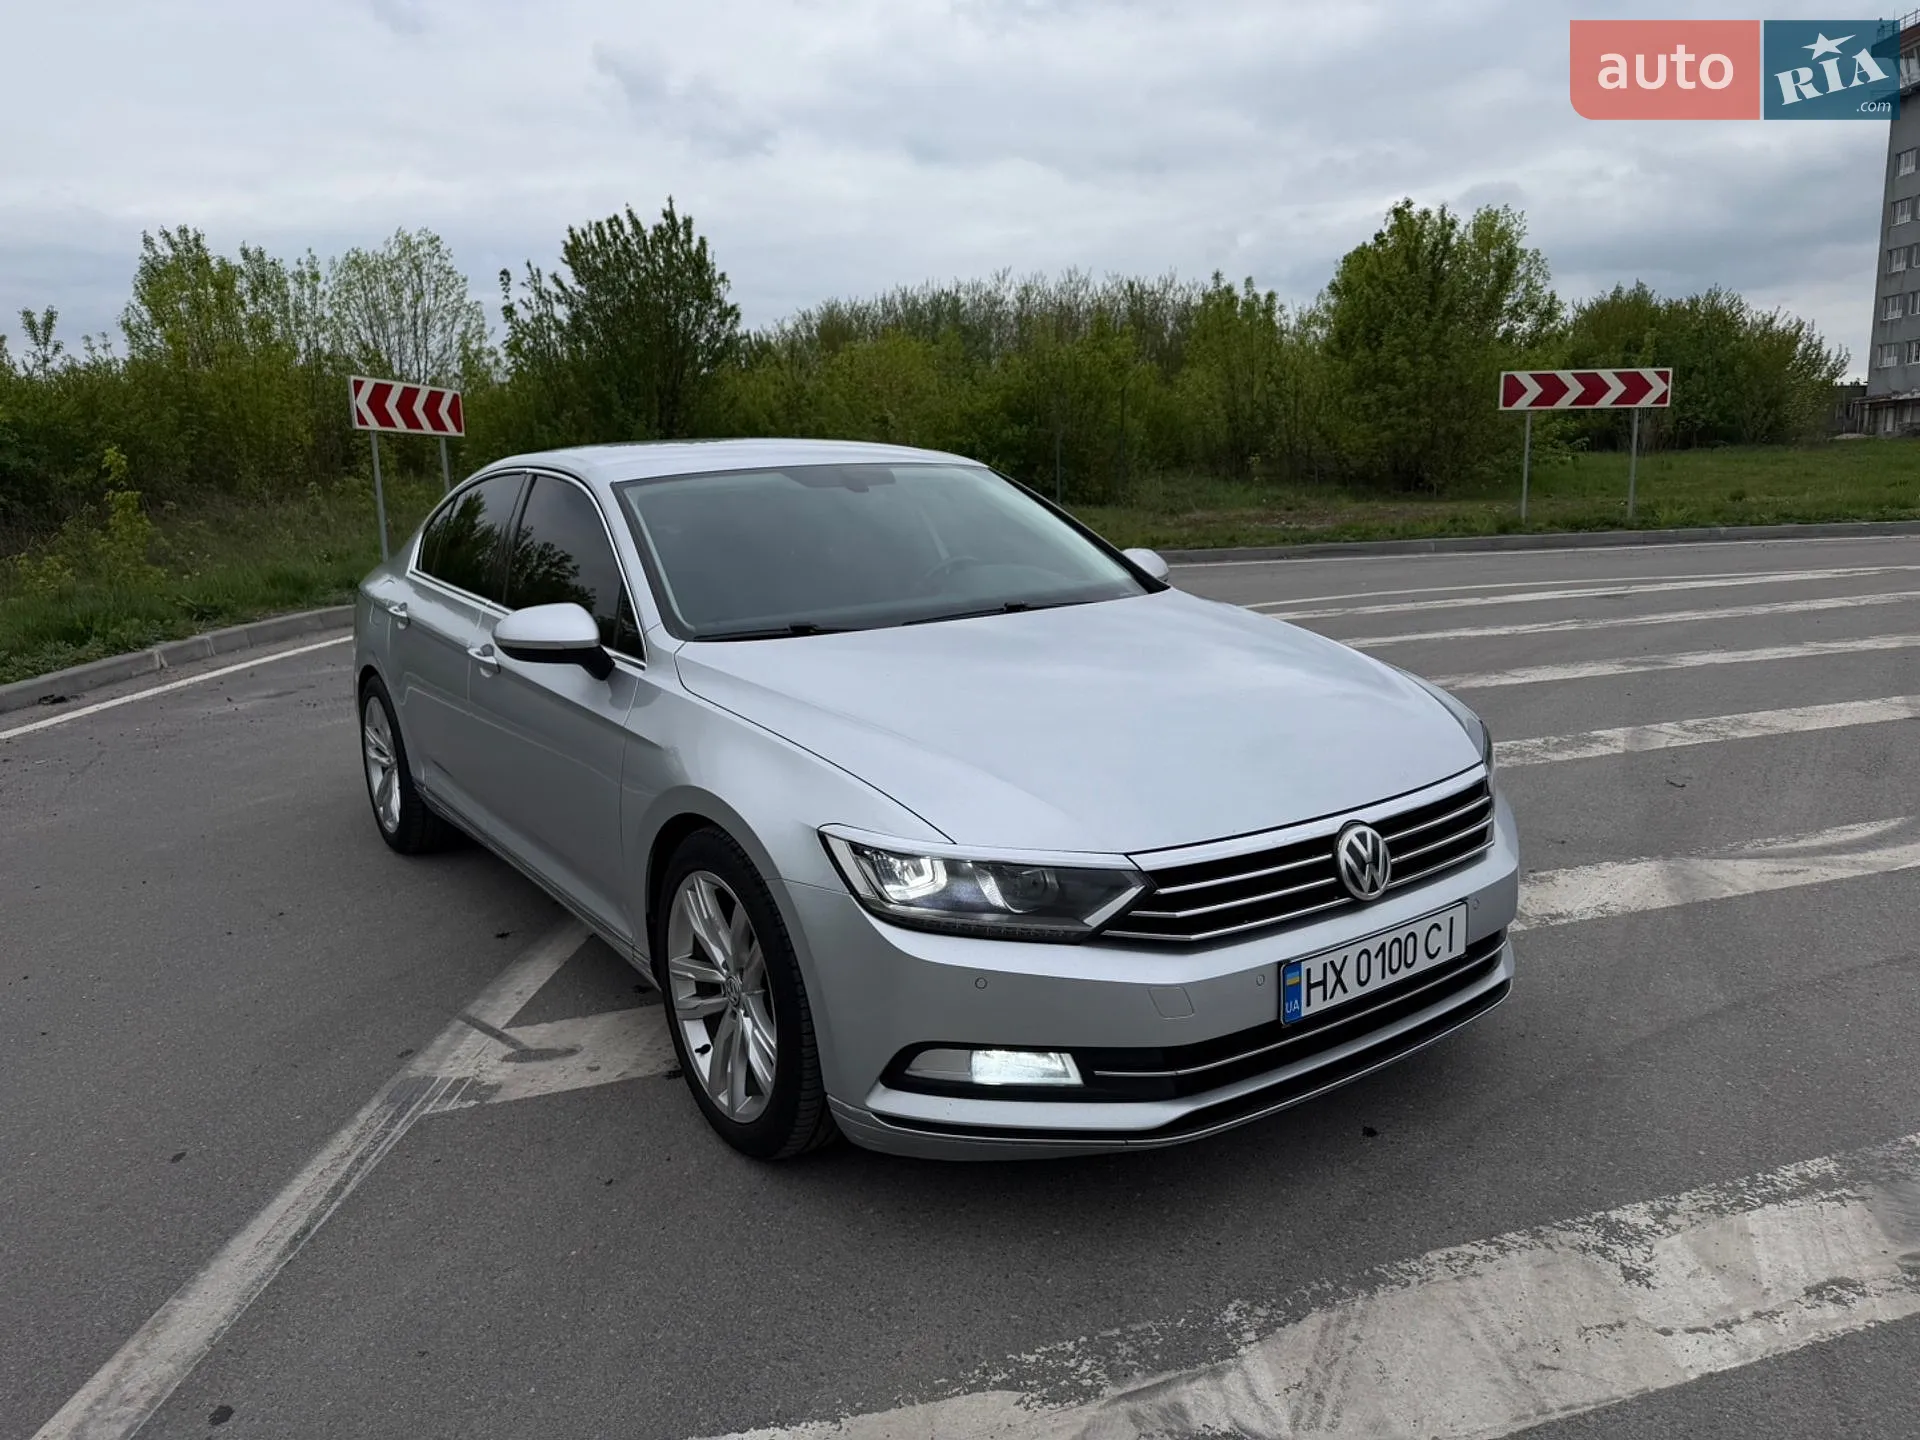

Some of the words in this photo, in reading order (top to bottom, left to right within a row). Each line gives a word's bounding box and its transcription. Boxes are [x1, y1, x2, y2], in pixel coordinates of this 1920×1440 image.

[1339, 826, 1390, 899] VW
[1306, 955, 1348, 1007] HX
[1356, 931, 1417, 987] 0100
[1425, 916, 1454, 960] CI
[1285, 1000, 1299, 1014] UA
